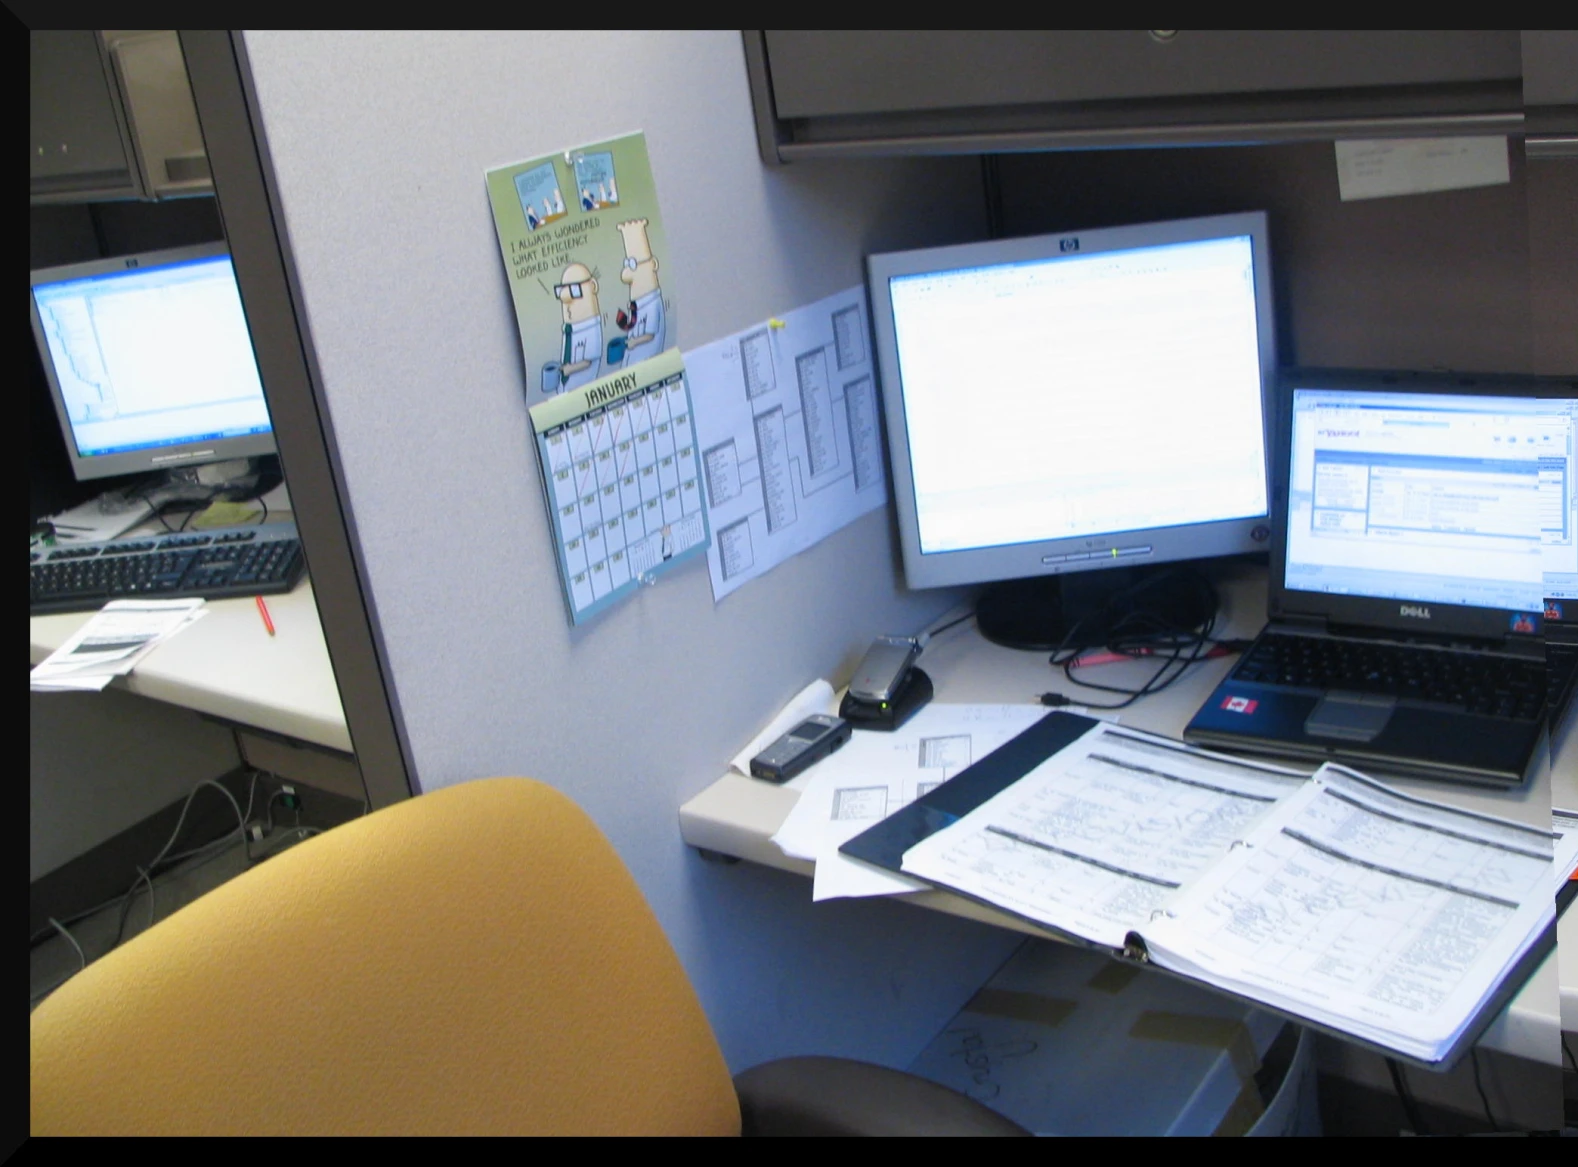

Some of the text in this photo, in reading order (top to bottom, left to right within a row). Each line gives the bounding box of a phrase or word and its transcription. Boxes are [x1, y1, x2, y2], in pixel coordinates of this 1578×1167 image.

[518, 233, 551, 250] ALWAYS
[554, 217, 600, 238] WONDERED
[512, 234, 589, 266] WHAT EFFICIENCY
[515, 261, 549, 280] LOOKED
[584, 371, 638, 409] JANUARY
[1400, 606, 1431, 620] DELL
